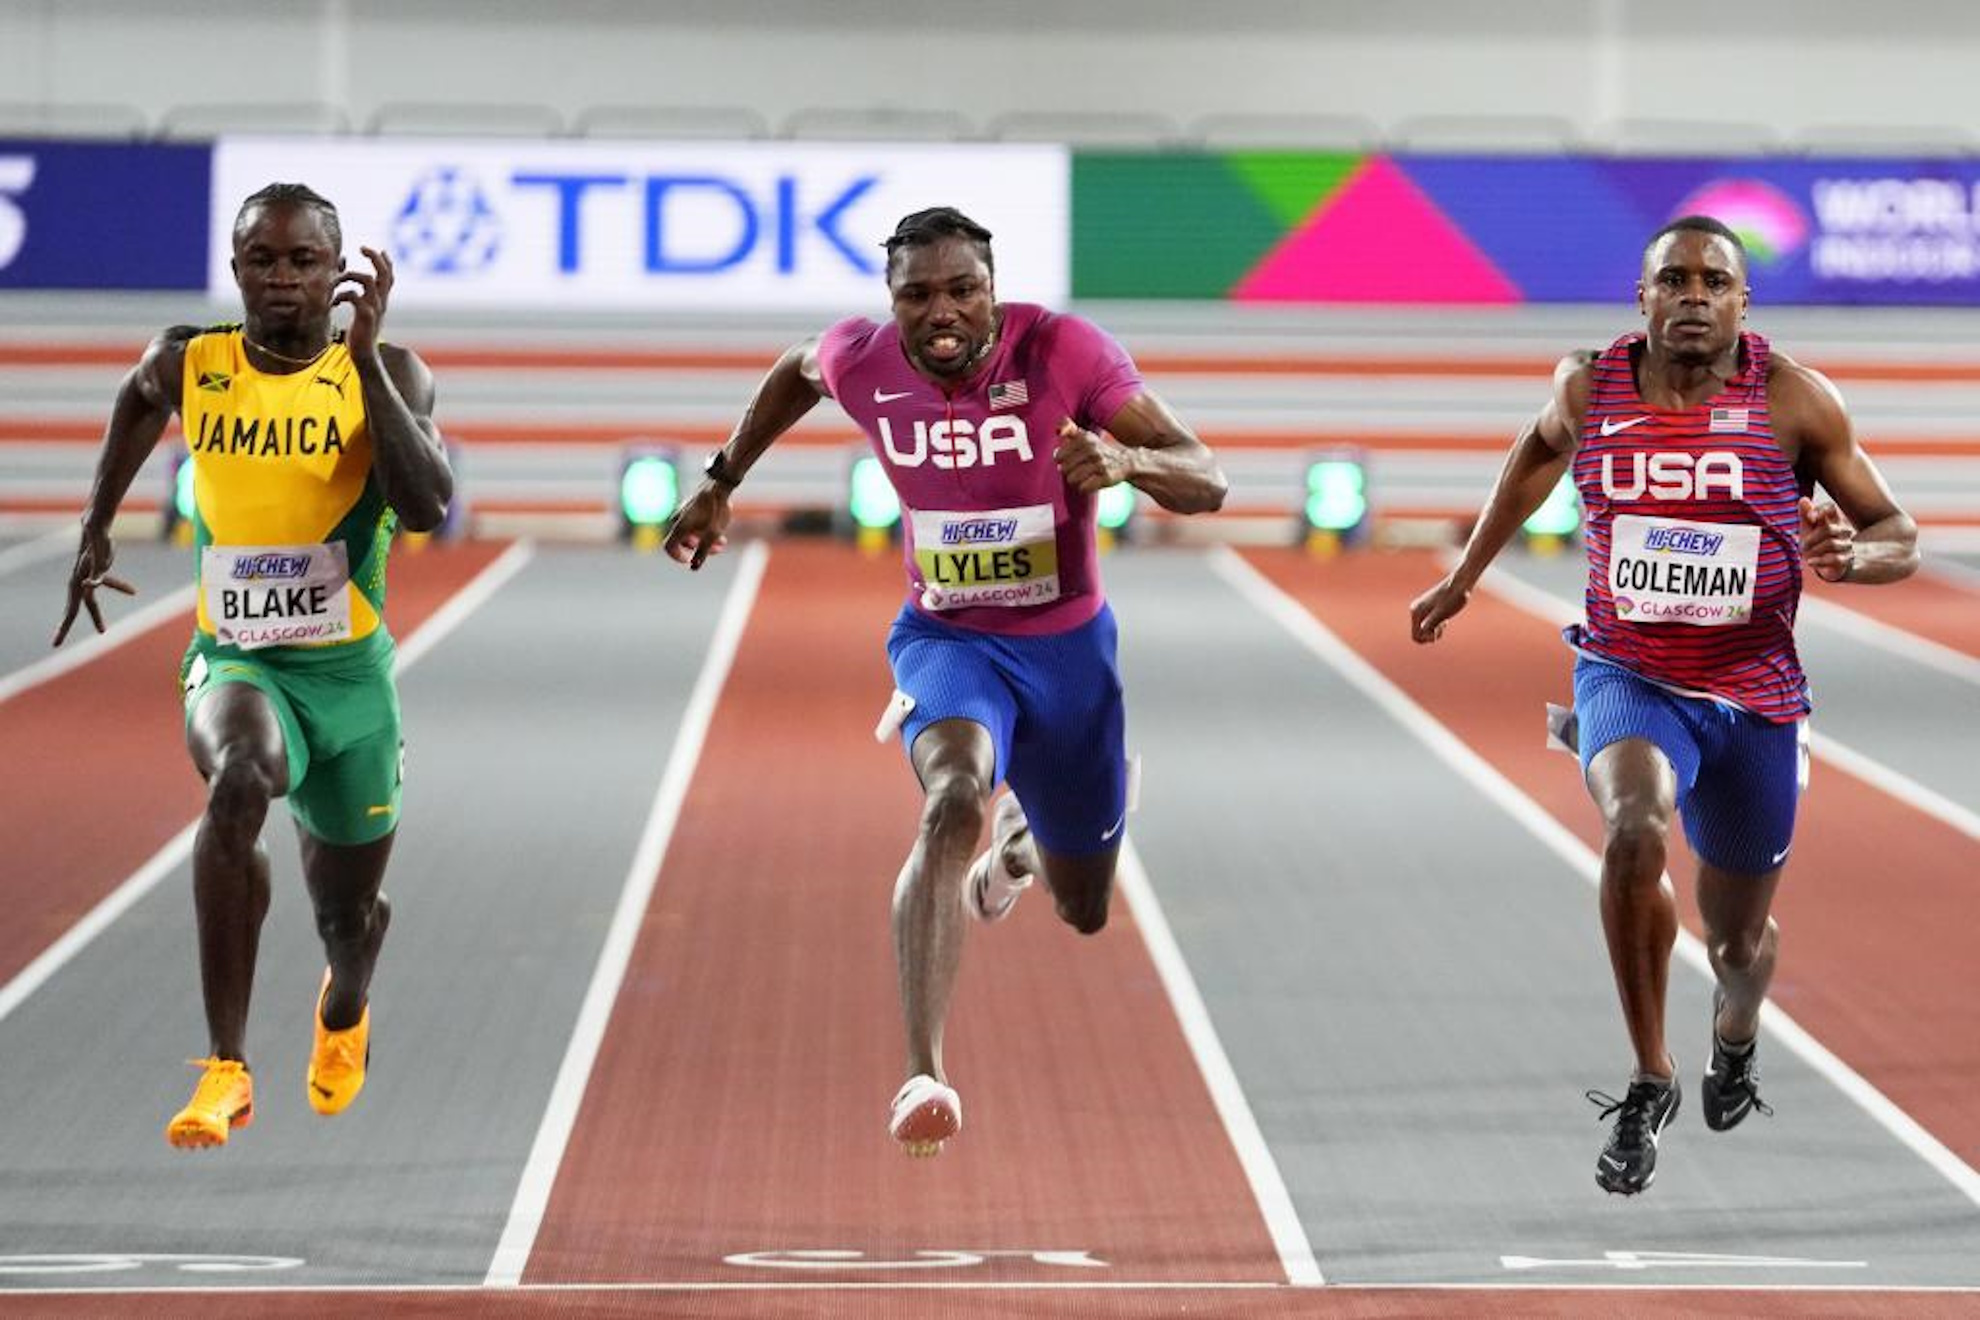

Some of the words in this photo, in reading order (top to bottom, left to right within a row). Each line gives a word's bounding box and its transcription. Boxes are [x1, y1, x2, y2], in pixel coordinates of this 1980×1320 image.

[511, 175, 881, 275] TDK
[1811, 178, 1980, 234] WORL
[193, 412, 344, 456] JAMAICA
[877, 414, 1034, 470] USA
[1602, 452, 1744, 501] USA
[934, 547, 1032, 583] LYLES
[1616, 557, 1747, 597] COLEMAN
[222, 585, 328, 620] BLAKE
[950, 586, 1032, 605] GLASGOW
[1641, 601, 1724, 618] GLASGOW
[237, 624, 323, 644] GLASGOW
